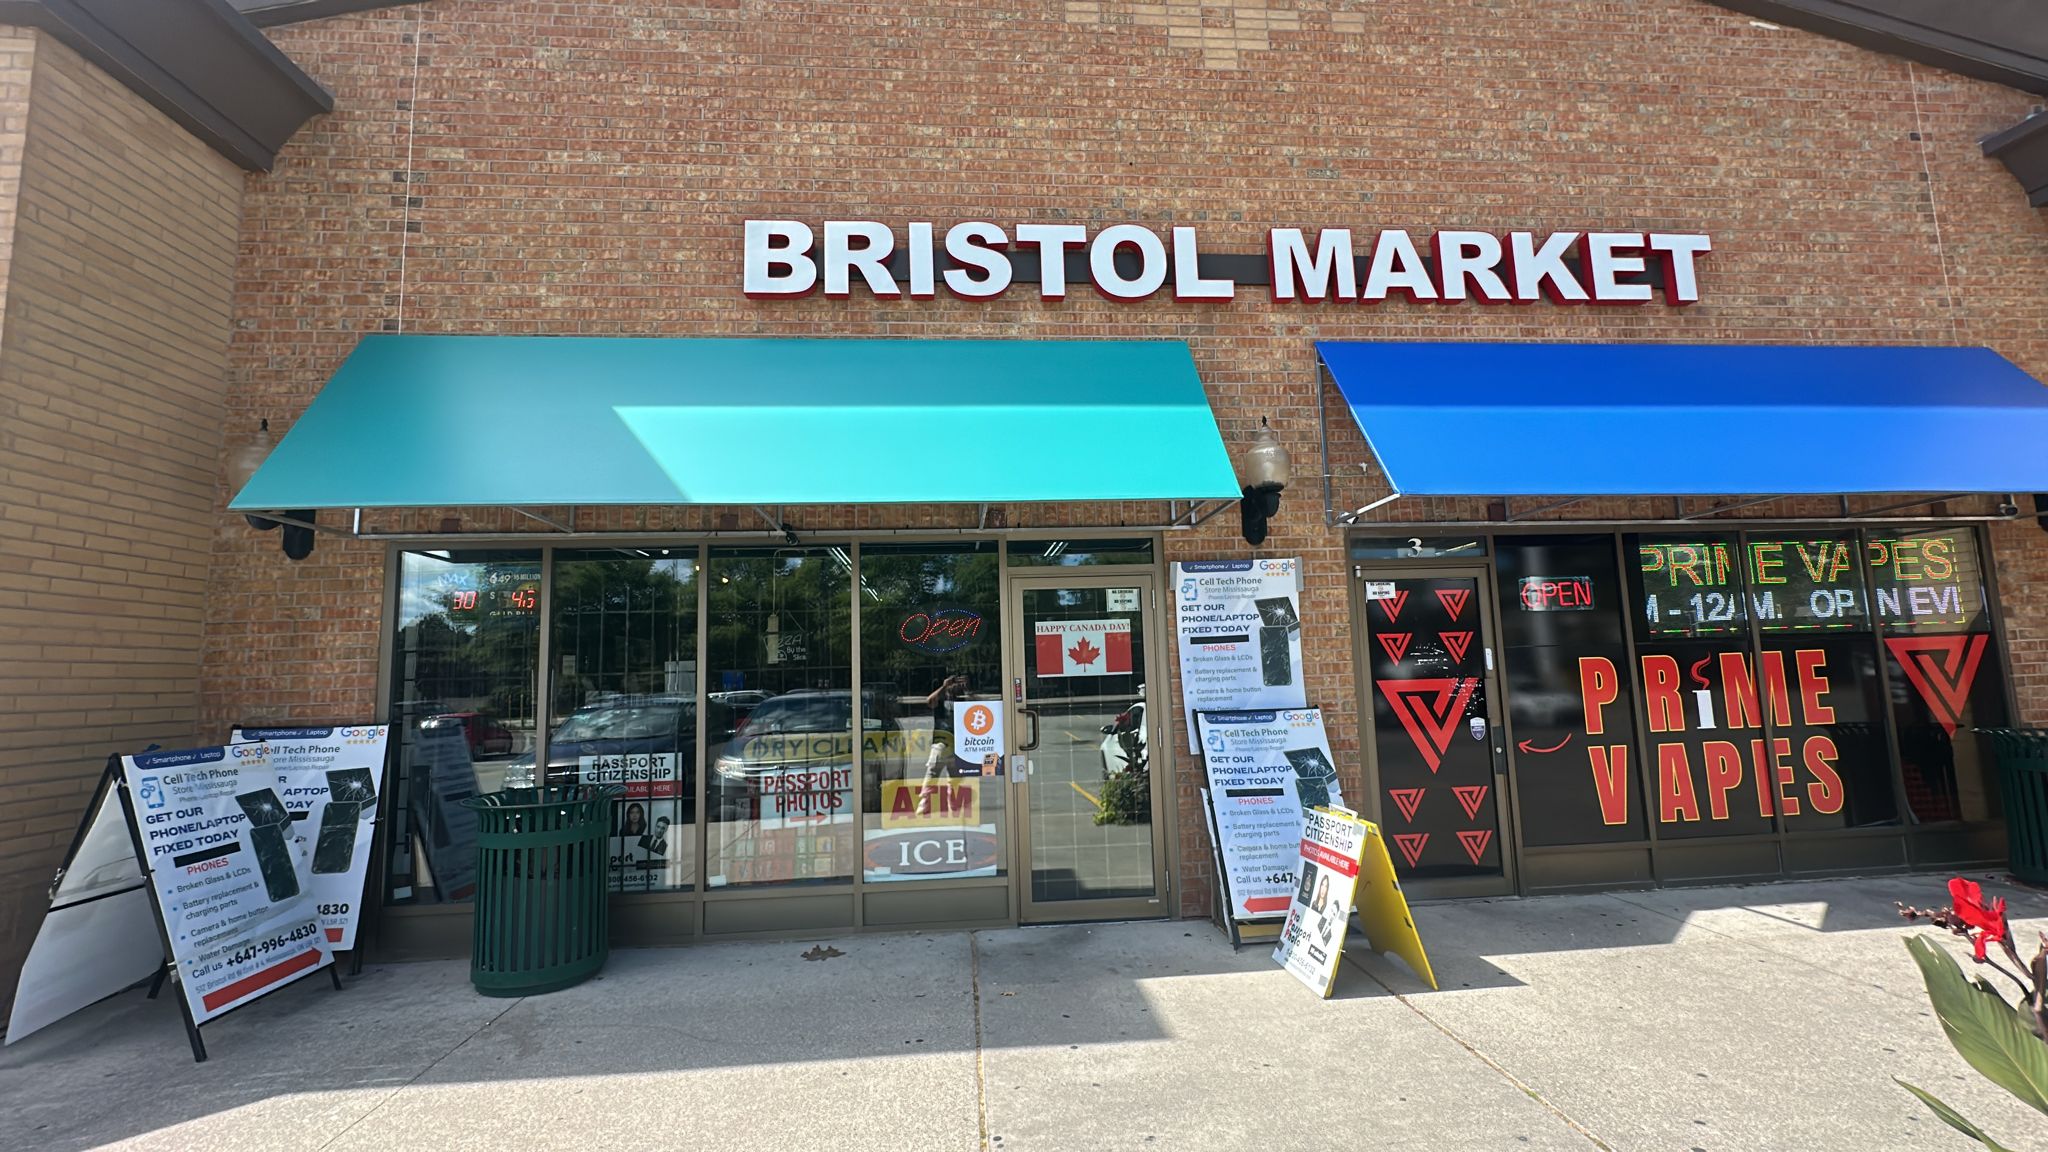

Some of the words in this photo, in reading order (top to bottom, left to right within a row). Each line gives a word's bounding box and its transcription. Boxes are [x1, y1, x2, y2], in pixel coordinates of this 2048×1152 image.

[743, 219, 1235, 300] BRISTOL
[1267, 227, 1711, 306] MARKET
[1407, 538, 1422, 557] 3
[1259, 560, 1296, 572] Google
[1199, 578, 1215, 586] Cell
[1216, 577, 1235, 585] Tech
[1236, 577, 1262, 585] Phone
[1223, 586, 1259, 594] Mississauga
[453, 591, 477, 610] 30
[1521, 581, 1592, 608] OPEN
[1810, 588, 1902, 618] OPN
[900, 612, 982, 643] Open
[1036, 624, 1067, 633] HAPPY
[1069, 624, 1107, 632] CANADA
[1109, 623, 1130, 631] DAY!
[1182, 614, 1260, 623] PHONE/LAPTOP
[1182, 626, 1212, 634] FIXED
[1214, 625, 1250, 633] TODAY
[1202, 644, 1236, 652] PHONES
[1195, 668, 1216, 676] Battery
[1216, 667, 1252, 675] replacement
[1283, 711, 1320, 722] Google
[341, 727, 385, 739] Google
[964, 737, 995, 746] bitcoin
[1261, 728, 1289, 736] Phone
[152, 754, 192, 765] Smartphone
[231, 743, 270, 760] Google
[283, 746, 306, 754] Tech
[308, 745, 341, 754] Phone
[751, 738, 802, 758] DRY
[288, 755, 335, 764] Mississauga
[592, 757, 667, 770] PASSPORT
[163, 774, 183, 785] Cell
[184, 771, 207, 782] Tech
[209, 768, 239, 779] Phone
[586, 768, 671, 781] CITIZENSHIP
[1212, 765, 1293, 775] PHONE/LAPTOP
[173, 784, 194, 795] Store
[764, 769, 851, 794] PASSPORT
[1215, 778, 1248, 786] FIXED
[1249, 777, 1285, 785] TODAY
[1587, 735, 1844, 825] VAPES
[775, 791, 843, 813] PHOTOS
[890, 785, 972, 821] ATM
[146, 812, 173, 825] GET
[176, 806, 204, 819] OUR
[149, 813, 246, 840] PHONE/LAPTOP
[1308, 813, 1353, 838] PASSPORT
[153, 840, 194, 856] FIXED
[195, 829, 240, 845] TODAY
[1269, 843, 1288, 851] home
[1305, 825, 1353, 852] CITIZENSHIP
[899, 839, 968, 866] ICE
[186, 858, 230, 875] PHONES
[1262, 864, 1289, 872] Damage
[177, 878, 204, 893] Broken
[204, 873, 226, 885] Glass
[232, 867, 252, 878] LCDs
[182, 894, 210, 910] Battery
[211, 883, 253, 902] replacement
[185, 905, 219, 920] charging
[220, 899, 239, 912] parts
[1290, 909, 1300, 922] Pro
[190, 922, 220, 937] Camera
[228, 913, 247, 924] home
[1287, 919, 1312, 942] Passport
[193, 926, 239, 948] replacement
[192, 965, 211, 979] Call
[212, 961, 224, 971] us
[226, 923, 317, 967] +647-996-4830
[198, 947, 221, 963] Water
[221, 938, 250, 953] Damage
